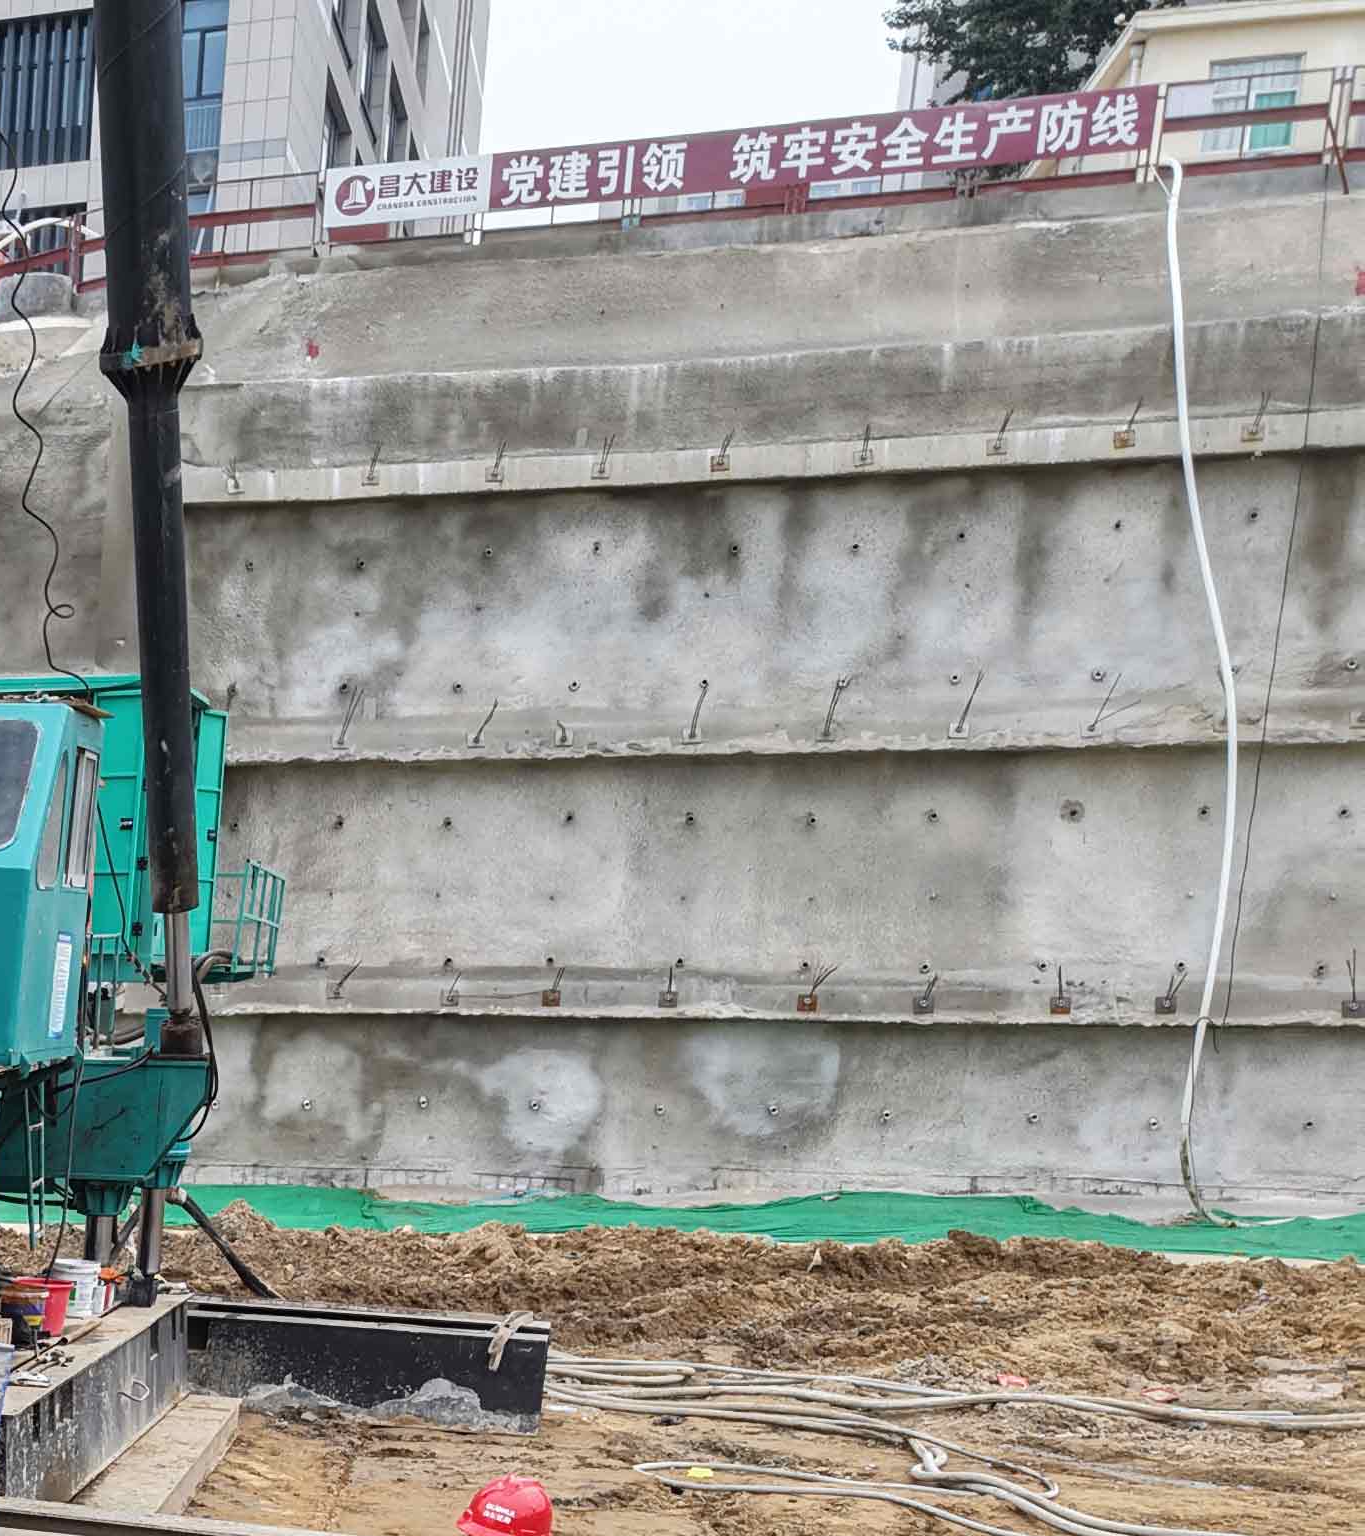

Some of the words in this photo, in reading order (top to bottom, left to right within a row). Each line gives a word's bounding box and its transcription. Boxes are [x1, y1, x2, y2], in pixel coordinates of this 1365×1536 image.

[379, 167, 479, 198] 昌大建设
[500, 142, 687, 206] 党建引领
[729, 92, 1140, 186] 筑牢安全生产防线
